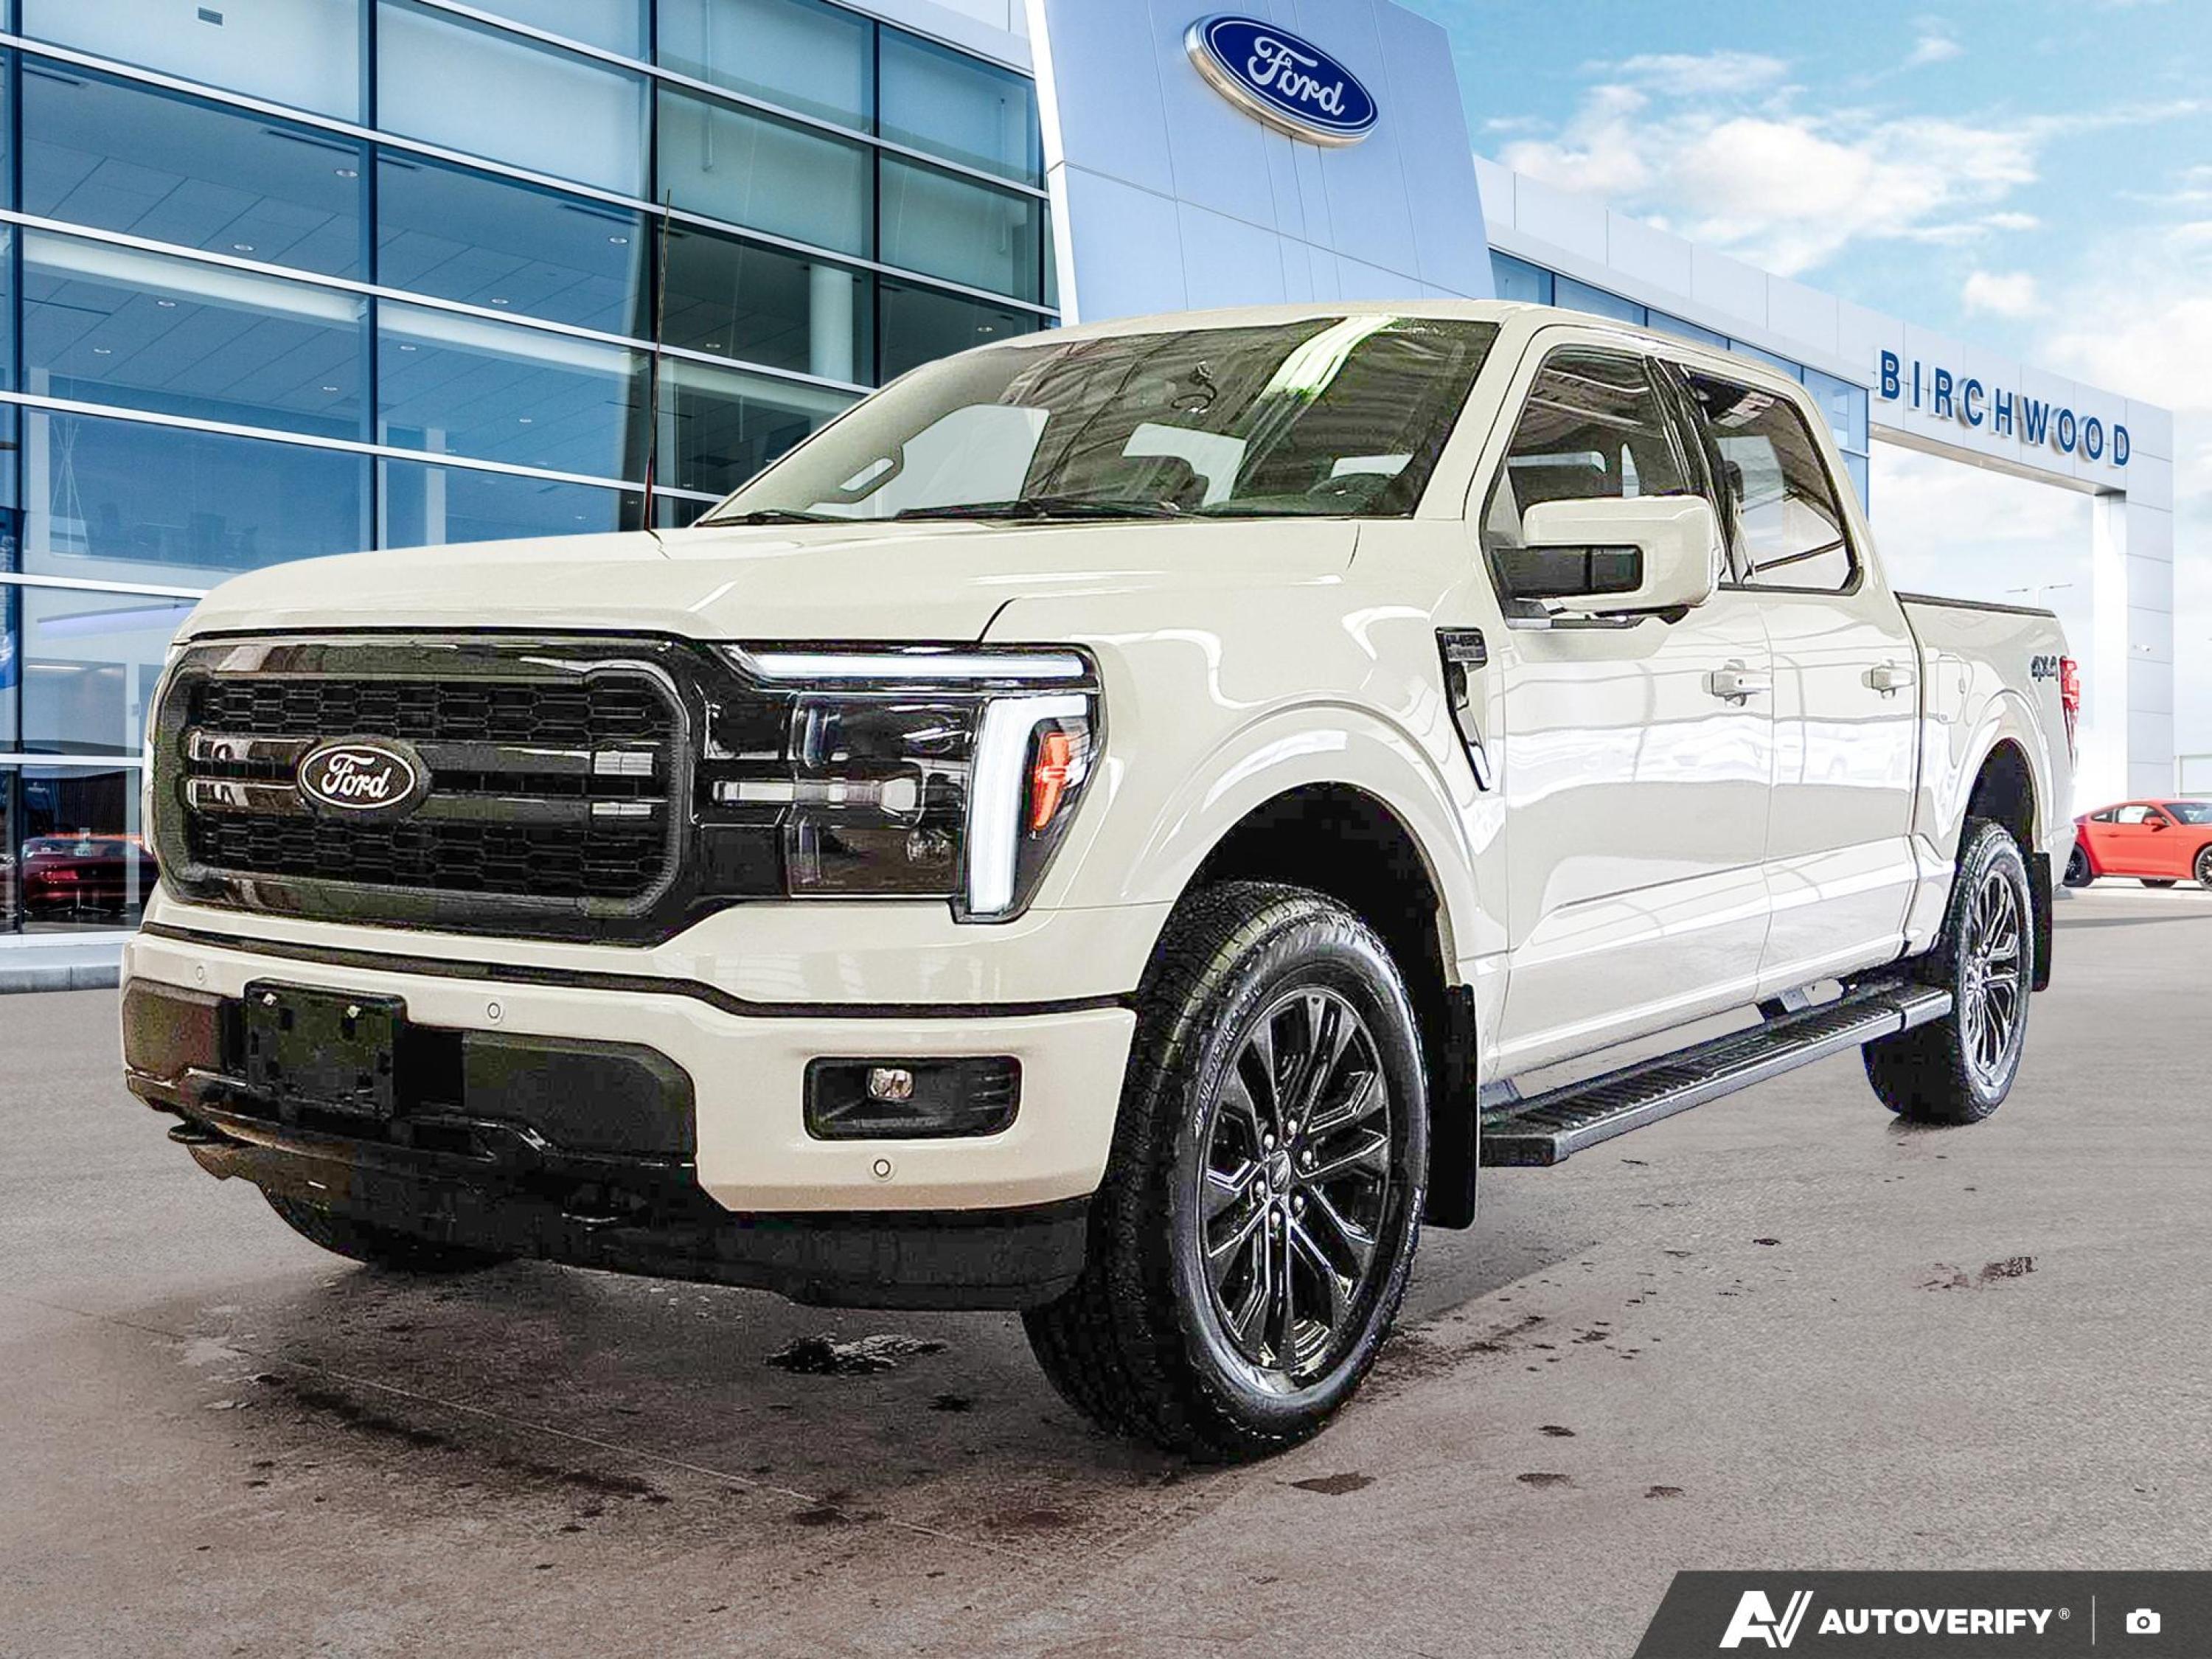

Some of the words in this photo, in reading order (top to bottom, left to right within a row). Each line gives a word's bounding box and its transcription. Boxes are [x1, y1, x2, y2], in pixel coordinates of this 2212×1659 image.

[1248, 36, 1346, 116] Ford
[1879, 349, 2130, 467] BIRCHWOOD
[321, 753, 392, 799] Ford
